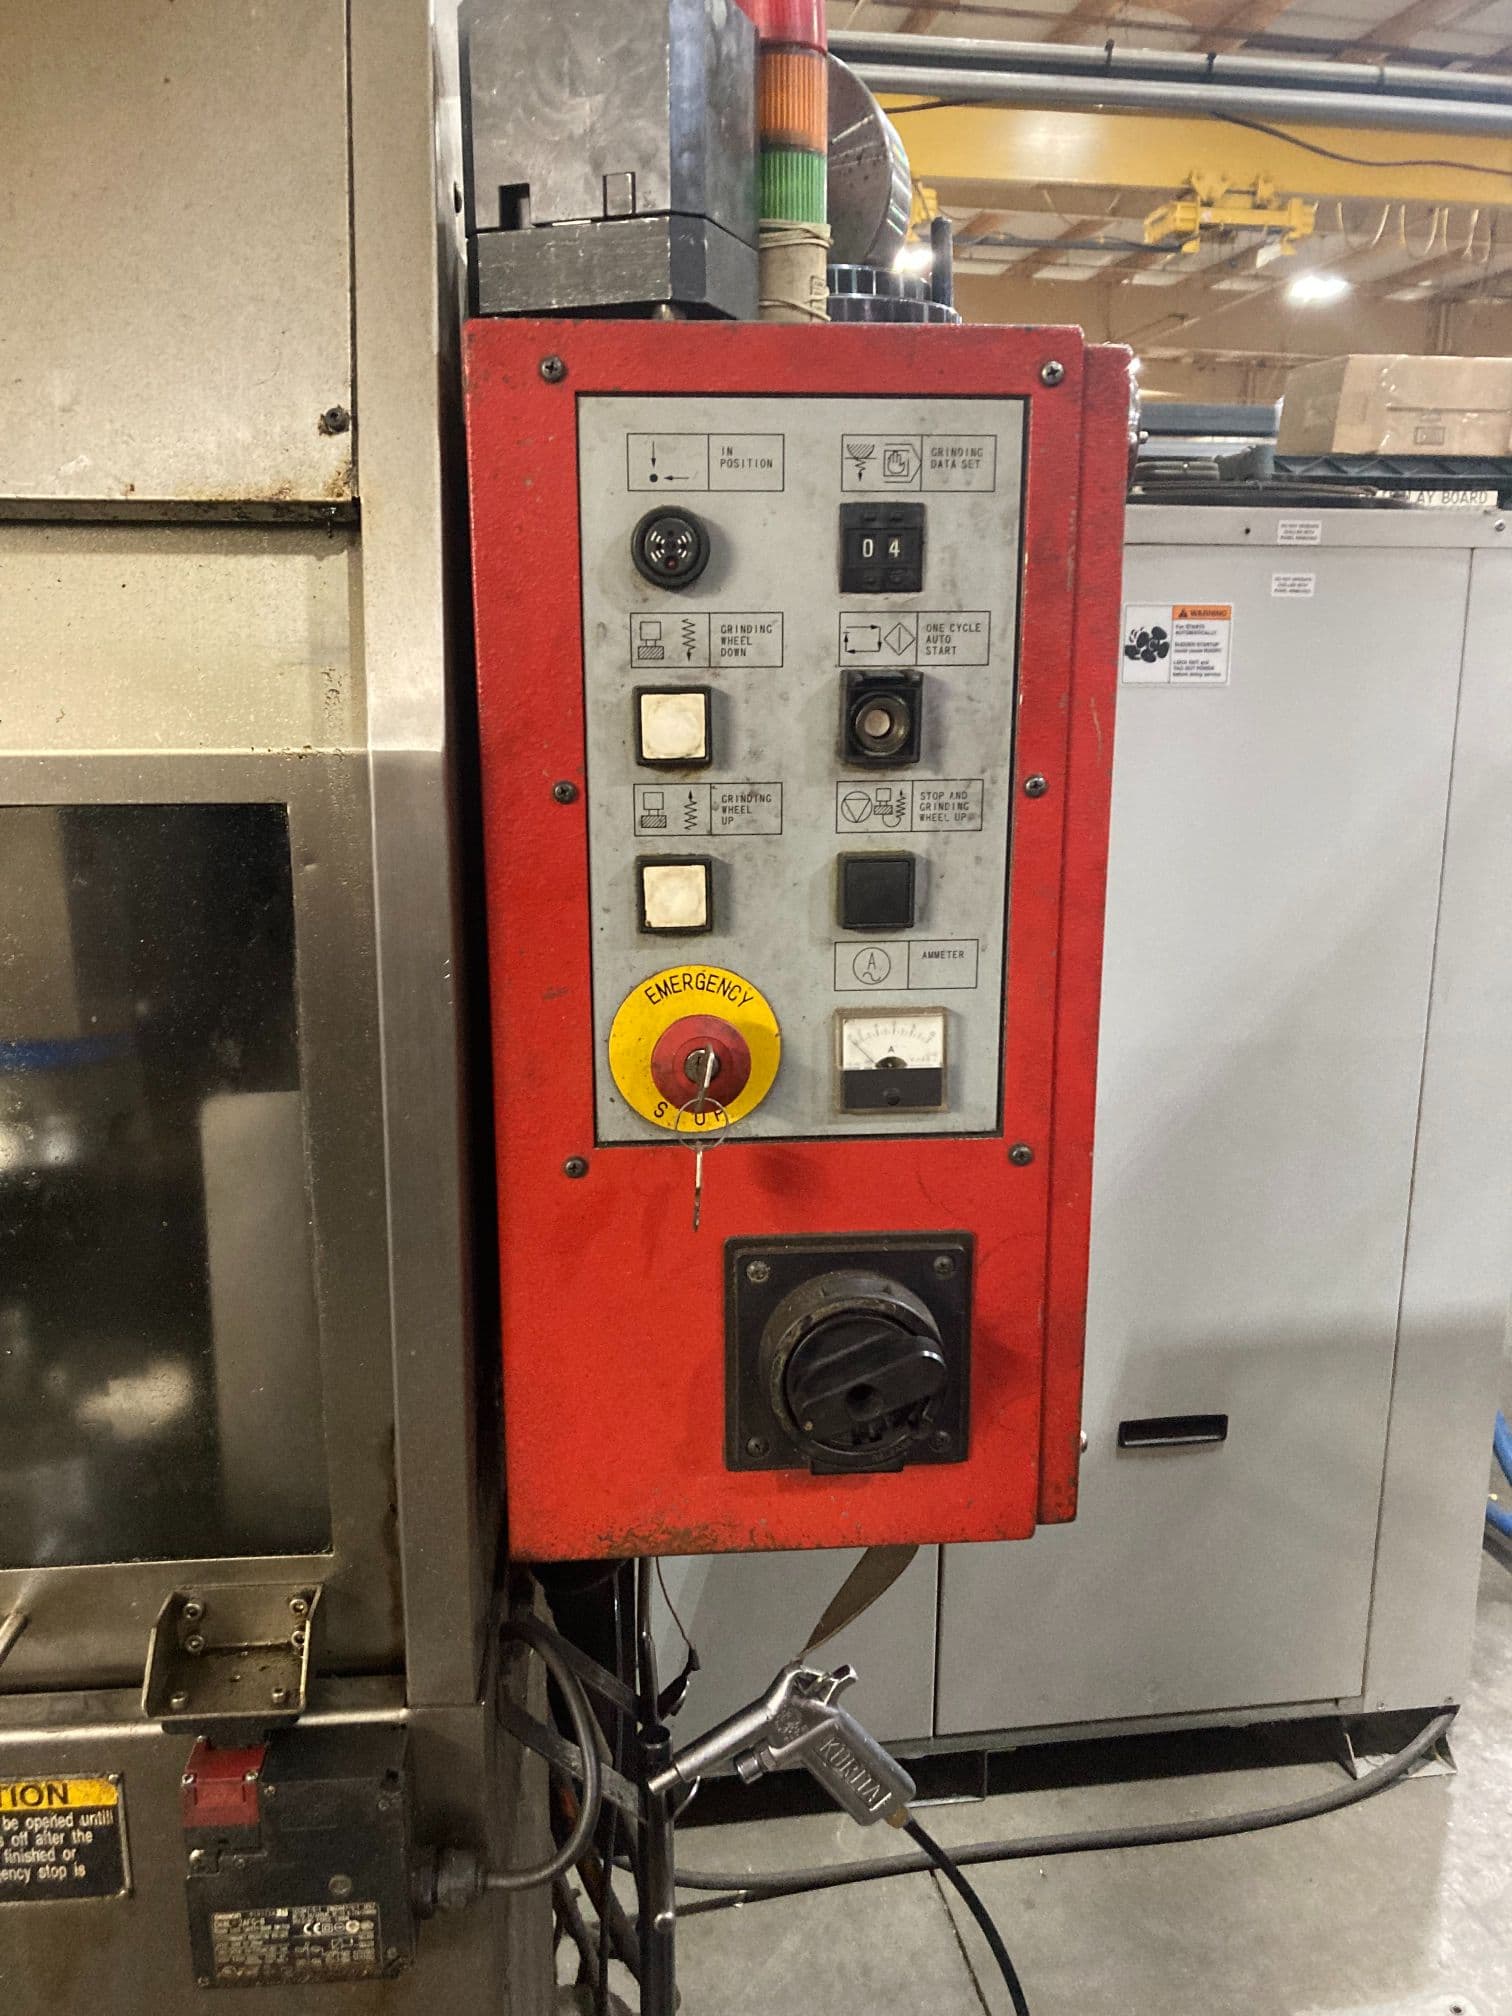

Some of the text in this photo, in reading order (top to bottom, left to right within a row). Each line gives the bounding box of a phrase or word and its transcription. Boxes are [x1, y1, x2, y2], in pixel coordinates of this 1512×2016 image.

[721, 446, 733, 456] IN
[930, 447, 984, 457] GRINDING
[720, 458, 773, 468] POSITION
[930, 459, 980, 469] DATA SET
[1441, 490, 1488, 504] BOARD
[720, 624, 773, 634] GRINDING
[926, 623, 981, 633] ONE CYCLE
[720, 635, 753, 646] WHEEL
[926, 634, 952, 645] AUTO
[720, 647, 746, 657] DOWN
[926, 646, 957, 656] START
[721, 794, 772, 803] GRINDING
[920, 791, 968, 801] STOP AND
[721, 805, 753, 815] WHEEL
[919, 802, 970, 811] GRINDING
[721, 816, 734, 825] UP
[919, 812, 967, 822] WHEEL UP
[921, 950, 965, 959] AMMETER
[644, 972, 755, 1008] EMERGENCY
[653, 1101, 726, 1126] SOP
[2, 1815, 19, 1831] be
[25, 1811, 75, 1832] opened
[11, 1830, 29, 1847] off
[35, 1828, 65, 1847] after
[71, 1828, 94, 1844] the
[4, 1847, 77, 1864] finished or
[0, 1861, 86, 1884] ency stop is
